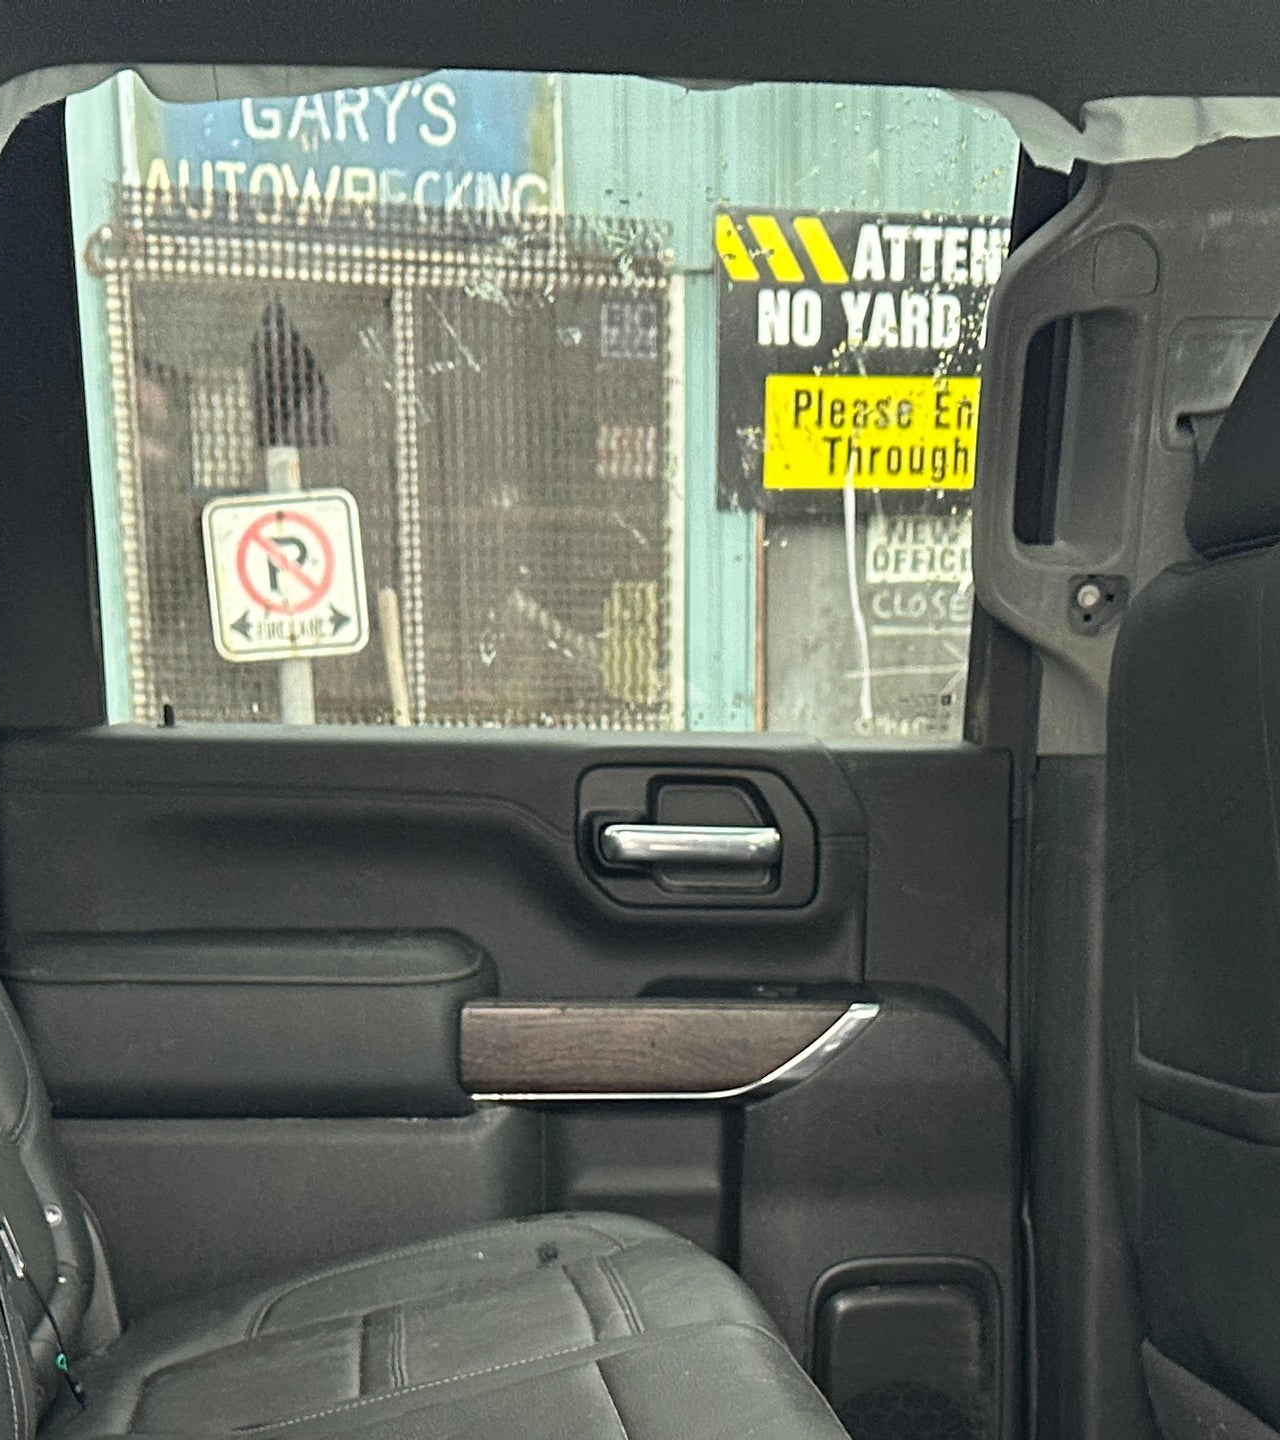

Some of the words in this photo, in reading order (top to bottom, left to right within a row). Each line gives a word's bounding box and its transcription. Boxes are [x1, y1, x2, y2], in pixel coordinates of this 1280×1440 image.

[241, 80, 458, 147] GARY'S
[852, 223, 1011, 285] ATTEN
[757, 288, 822, 347] NO
[840, 290, 961, 349] YARD
[793, 388, 913, 430] Please
[823, 436, 969, 483] Through
